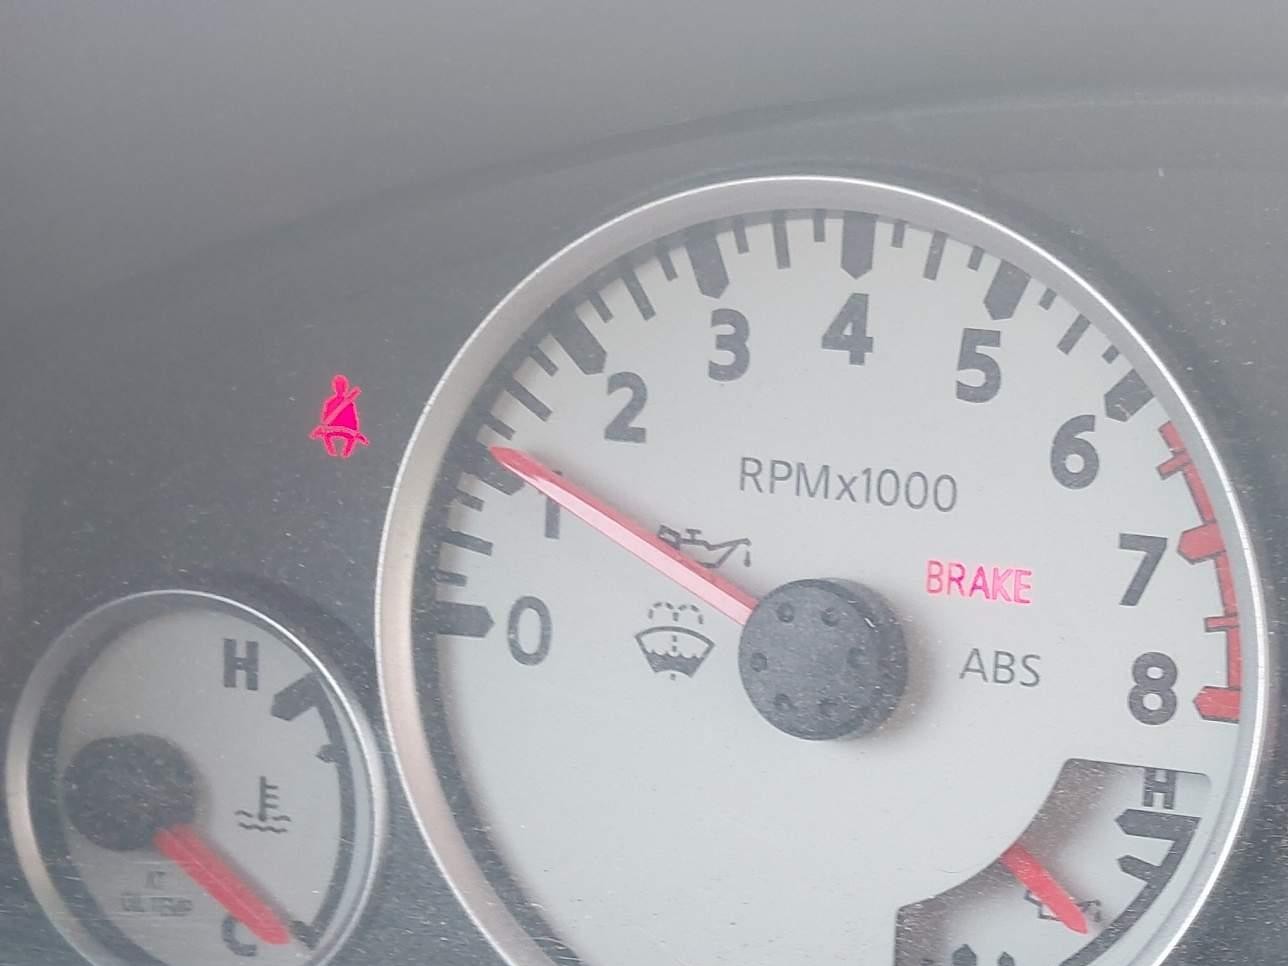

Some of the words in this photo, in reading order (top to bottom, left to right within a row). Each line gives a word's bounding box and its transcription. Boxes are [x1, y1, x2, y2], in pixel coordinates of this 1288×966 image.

[708, 308, 750, 381] 3
[821, 293, 873, 365] 4
[956, 328, 1001, 403] 5
[604, 372, 647, 443] 2
[739, 457, 957, 512] RPMx1000
[1050, 414, 1099, 489] 6
[926, 560, 1032, 604] BRAKE
[1119, 533, 1168, 606] 7
[224, 639, 259, 690] H
[507, 596, 552, 666] 0
[959, 648, 1041, 687] ABS
[1127, 652, 1178, 725] 8
[1143, 767, 1176, 809] H
